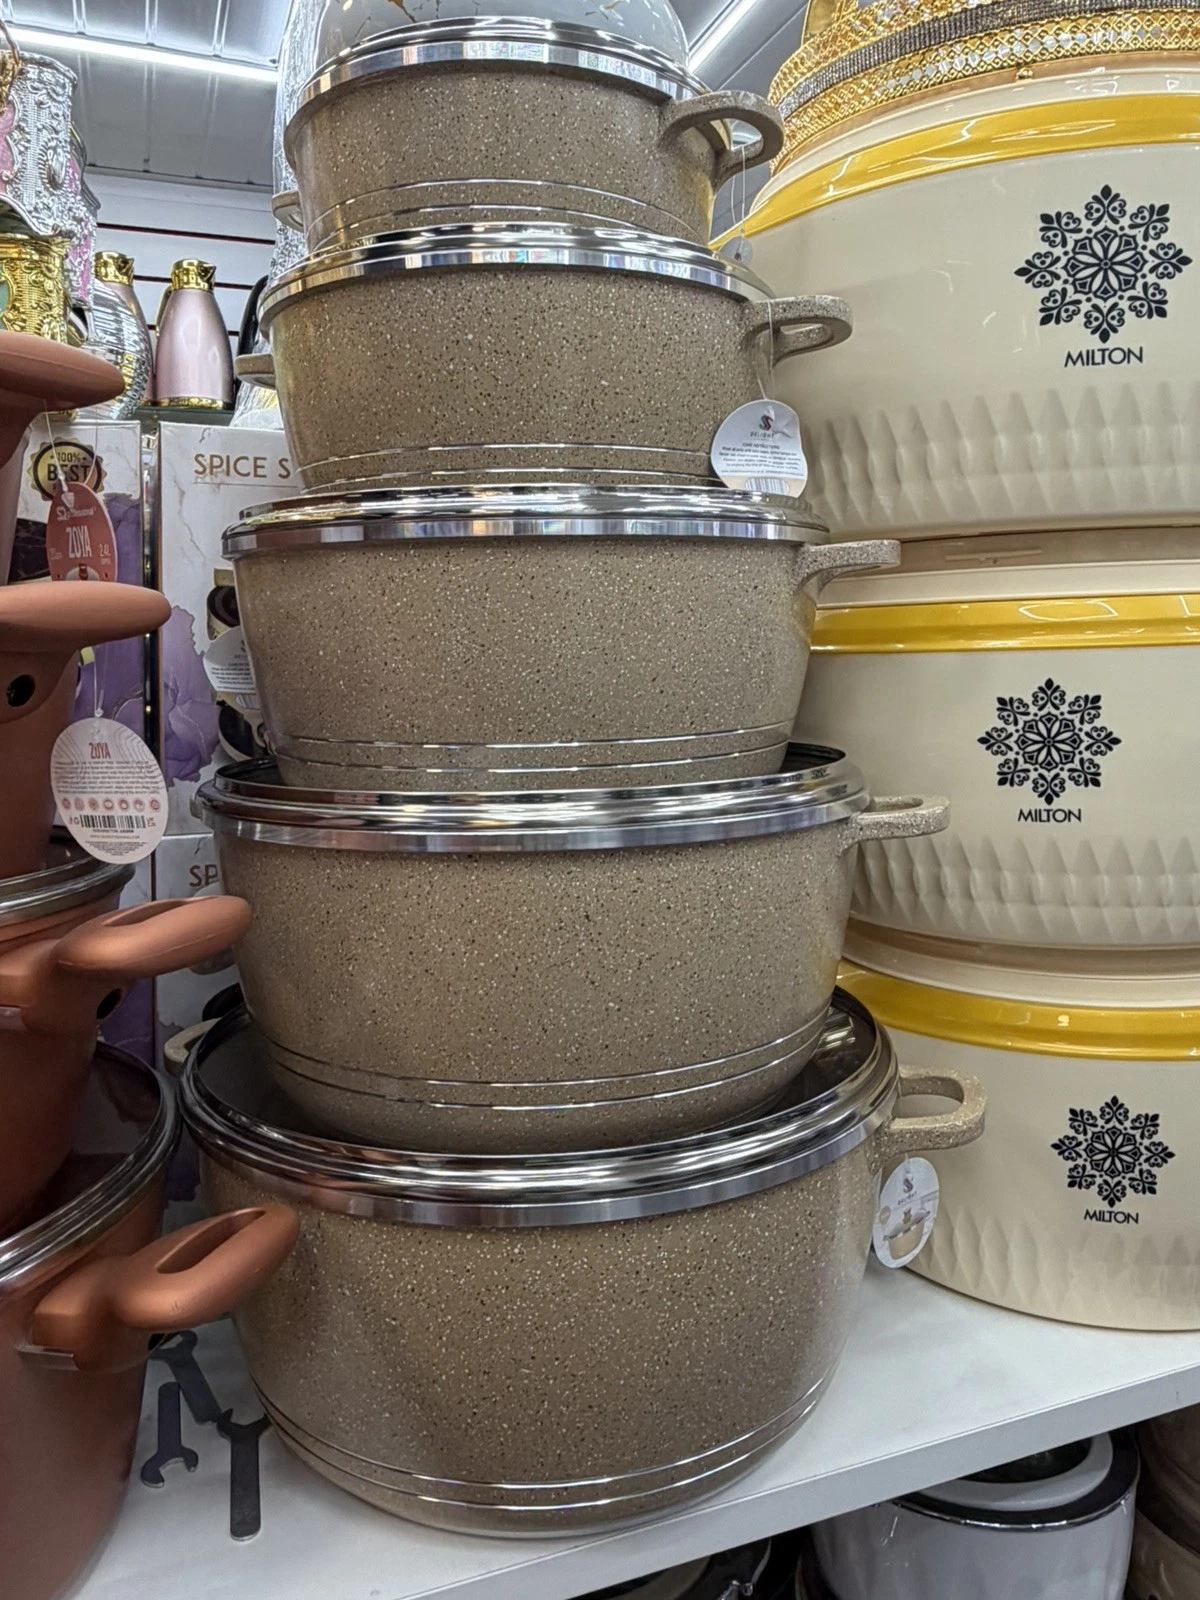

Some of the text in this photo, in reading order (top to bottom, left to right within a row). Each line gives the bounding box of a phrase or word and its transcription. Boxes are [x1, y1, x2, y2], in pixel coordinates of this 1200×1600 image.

[1064, 346, 1143, 368] MILTON
[46, 463, 91, 482] BEST
[194, 453, 267, 478] SPICE
[65, 525, 92, 559] ZOYA
[88, 742, 112, 759] ZOYA
[1017, 808, 1082, 823] MILTON
[1084, 1209, 1139, 1224] MILTON
